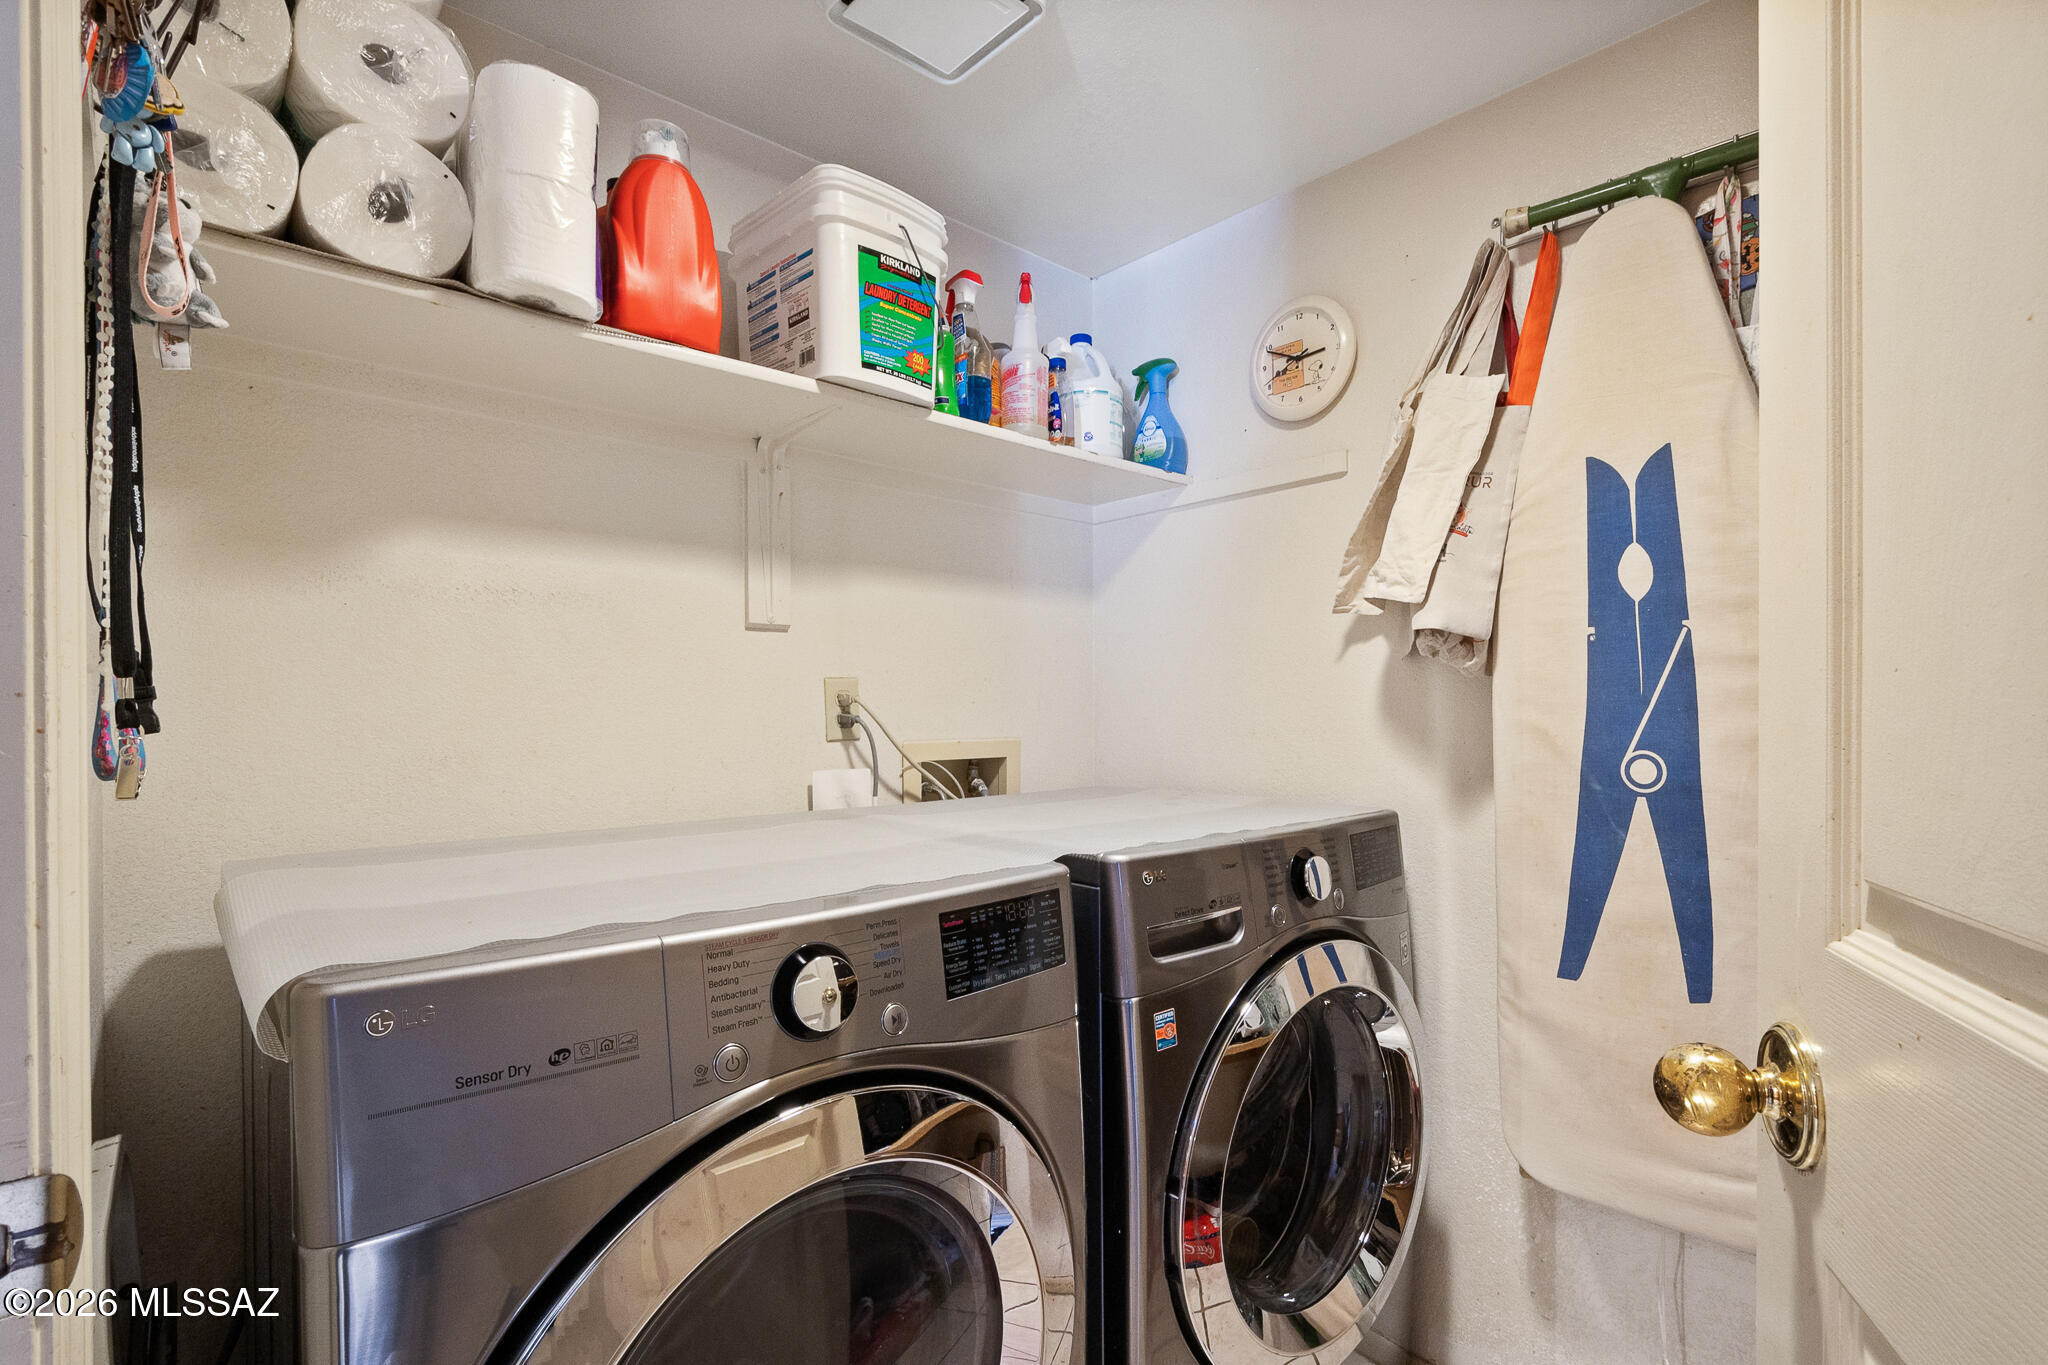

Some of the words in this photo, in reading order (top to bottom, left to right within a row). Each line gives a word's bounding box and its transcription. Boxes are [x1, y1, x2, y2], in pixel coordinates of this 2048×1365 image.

[880, 254, 921, 278] KIRKLAND
[864, 281, 898, 305] LAUNDRY
[897, 294, 932, 319] DETERGENT
[880, 301, 895, 311] Super
[894, 307, 922, 322] Concentrate
[1296, 312, 1304, 321] 12
[1330, 323, 1335, 331] 2
[913, 353, 924, 364] 200
[873, 930, 899, 941] Delicates
[880, 941, 900, 950] Towels
[706, 948, 734, 960] Normal
[707, 963, 731, 974] Heavy
[733, 959, 750, 969] Duty
[873, 959, 890, 969] Speed
[891, 957, 902, 965] Dry
[892, 969, 903, 977] Dry
[708, 976, 739, 989] Bedding
[710, 986, 758, 1004] Antibacterial
[869, 982, 905, 997] Downloaded
[711, 1008, 733, 1019] Steam
[712, 1023, 736, 1035] Steam
[455, 1069, 504, 1089] Sensor
[508, 1064, 531, 1079] Dry
